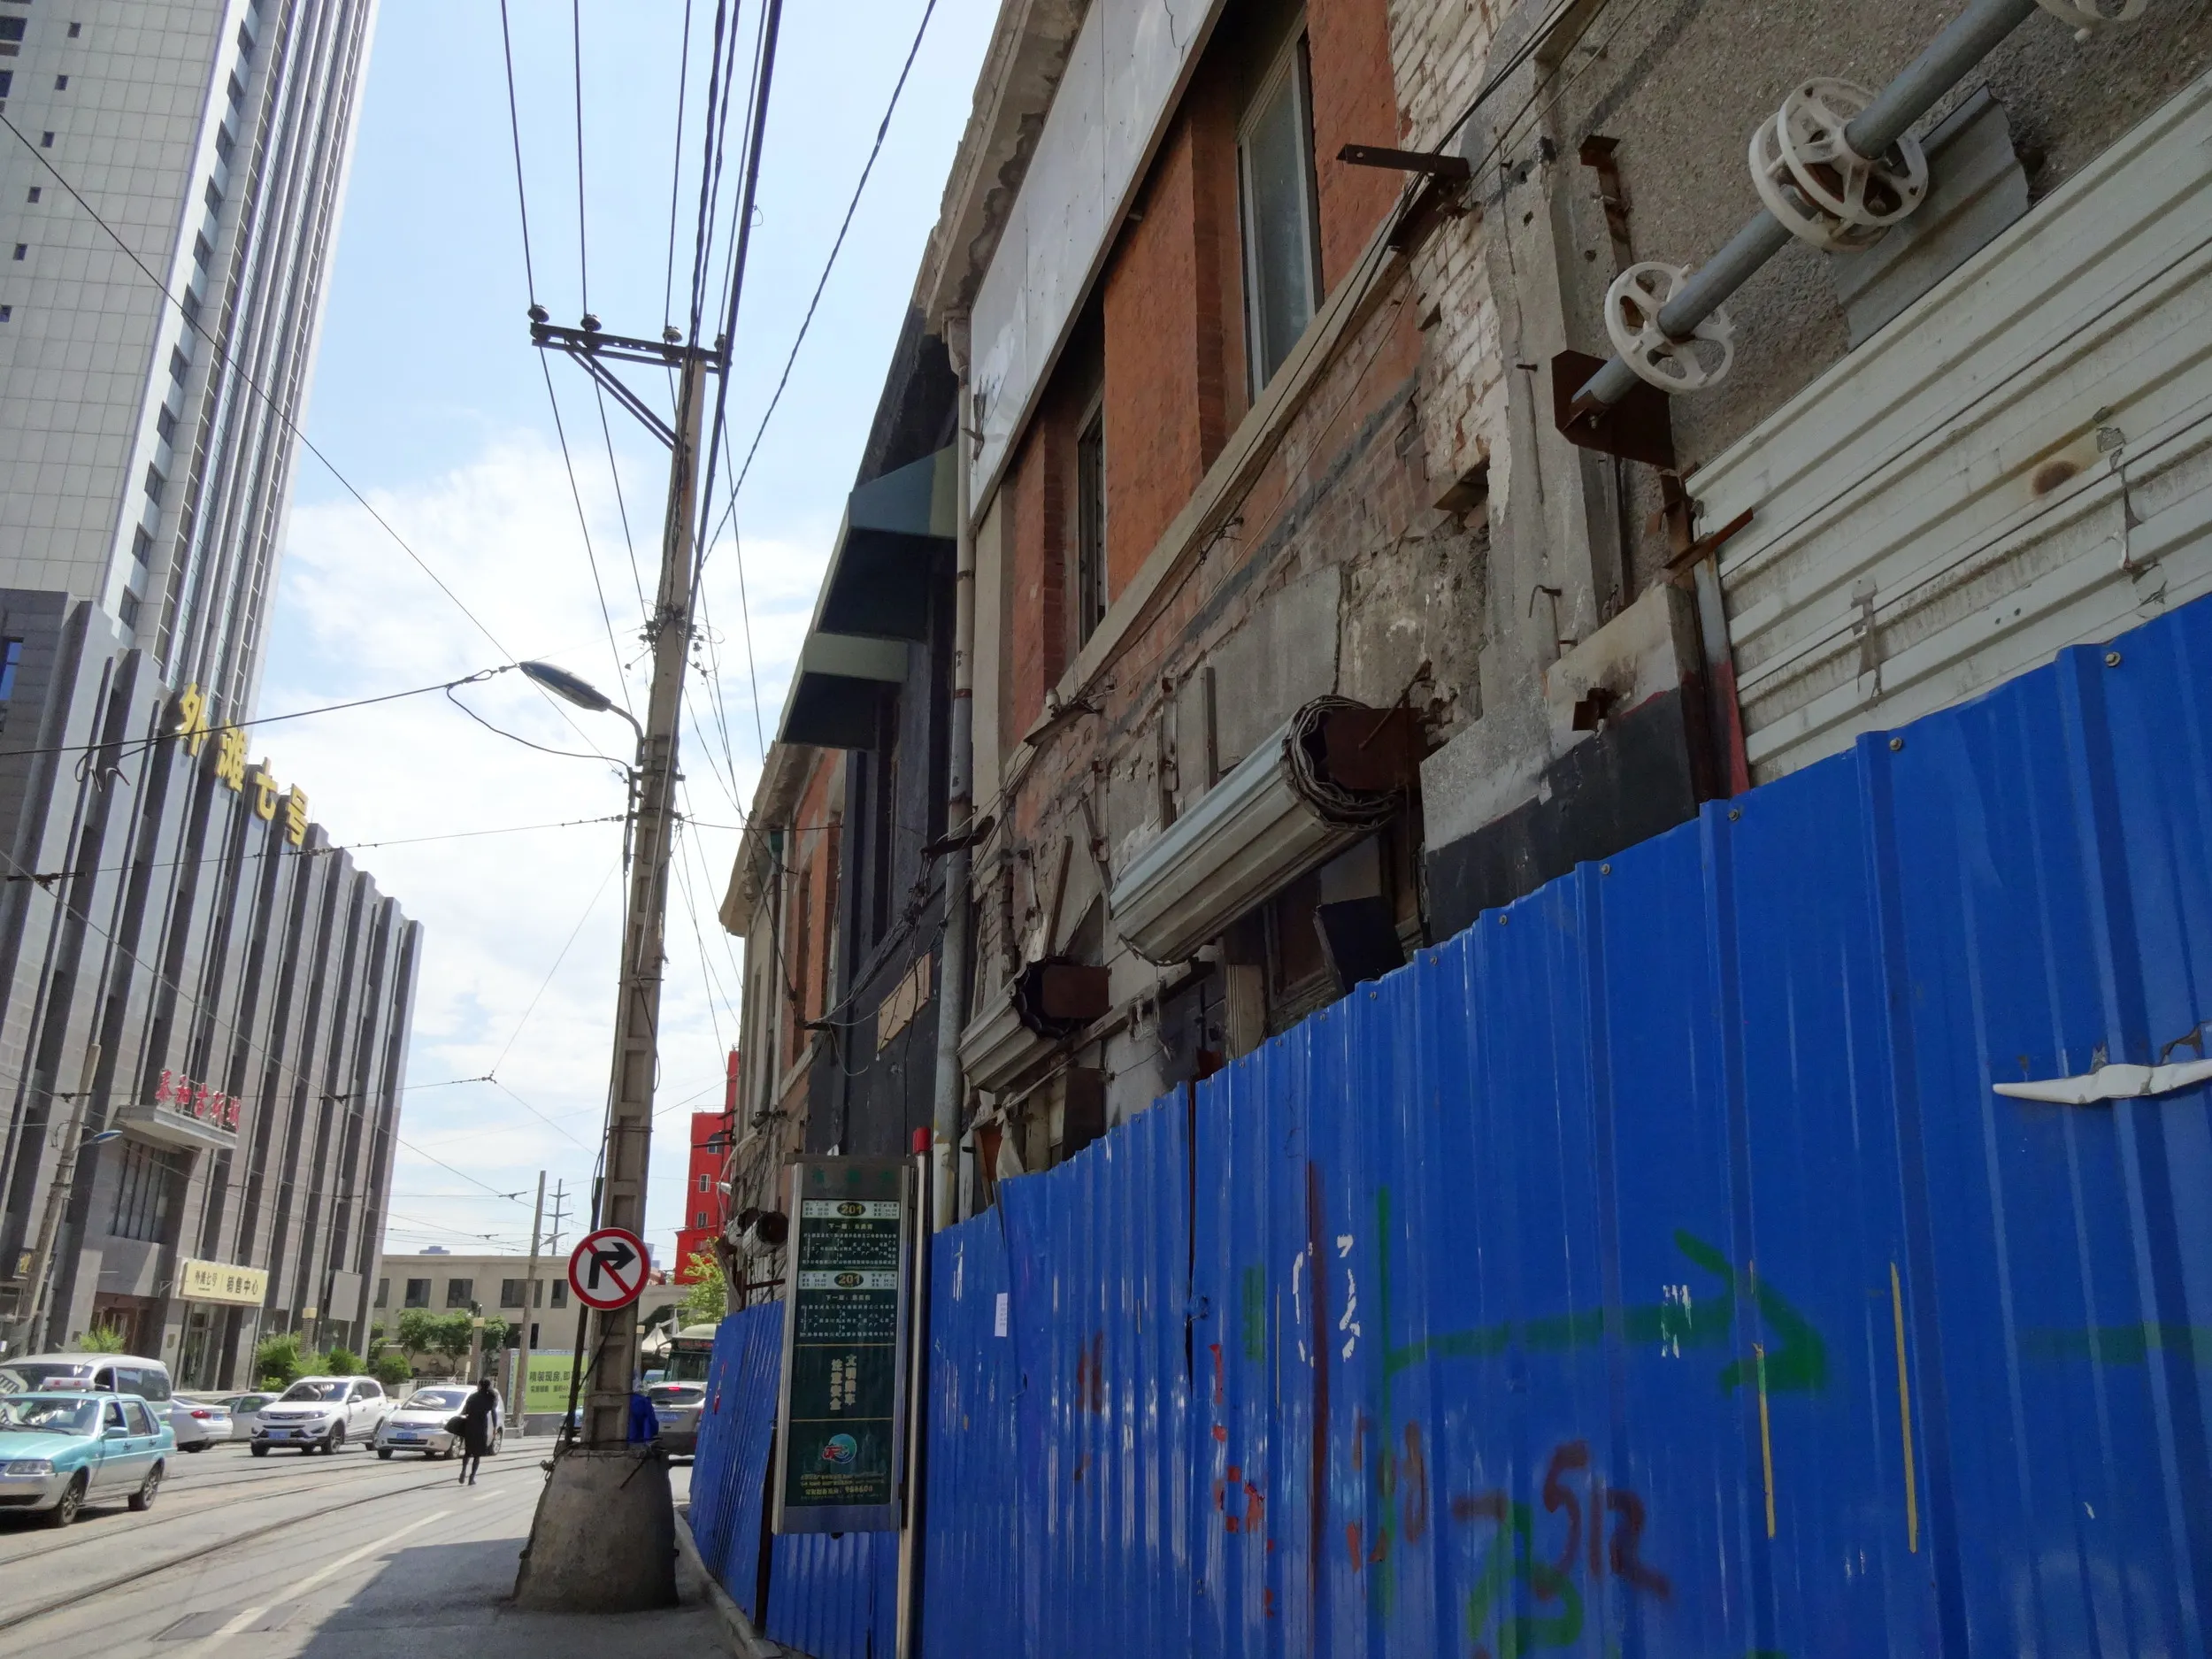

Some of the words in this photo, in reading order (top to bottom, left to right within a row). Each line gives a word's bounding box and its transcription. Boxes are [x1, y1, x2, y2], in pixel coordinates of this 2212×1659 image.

[841, 1203, 863, 1216] 201
[227, 1275, 258, 1295] 销售中心
[839, 1273, 861, 1285] 201
